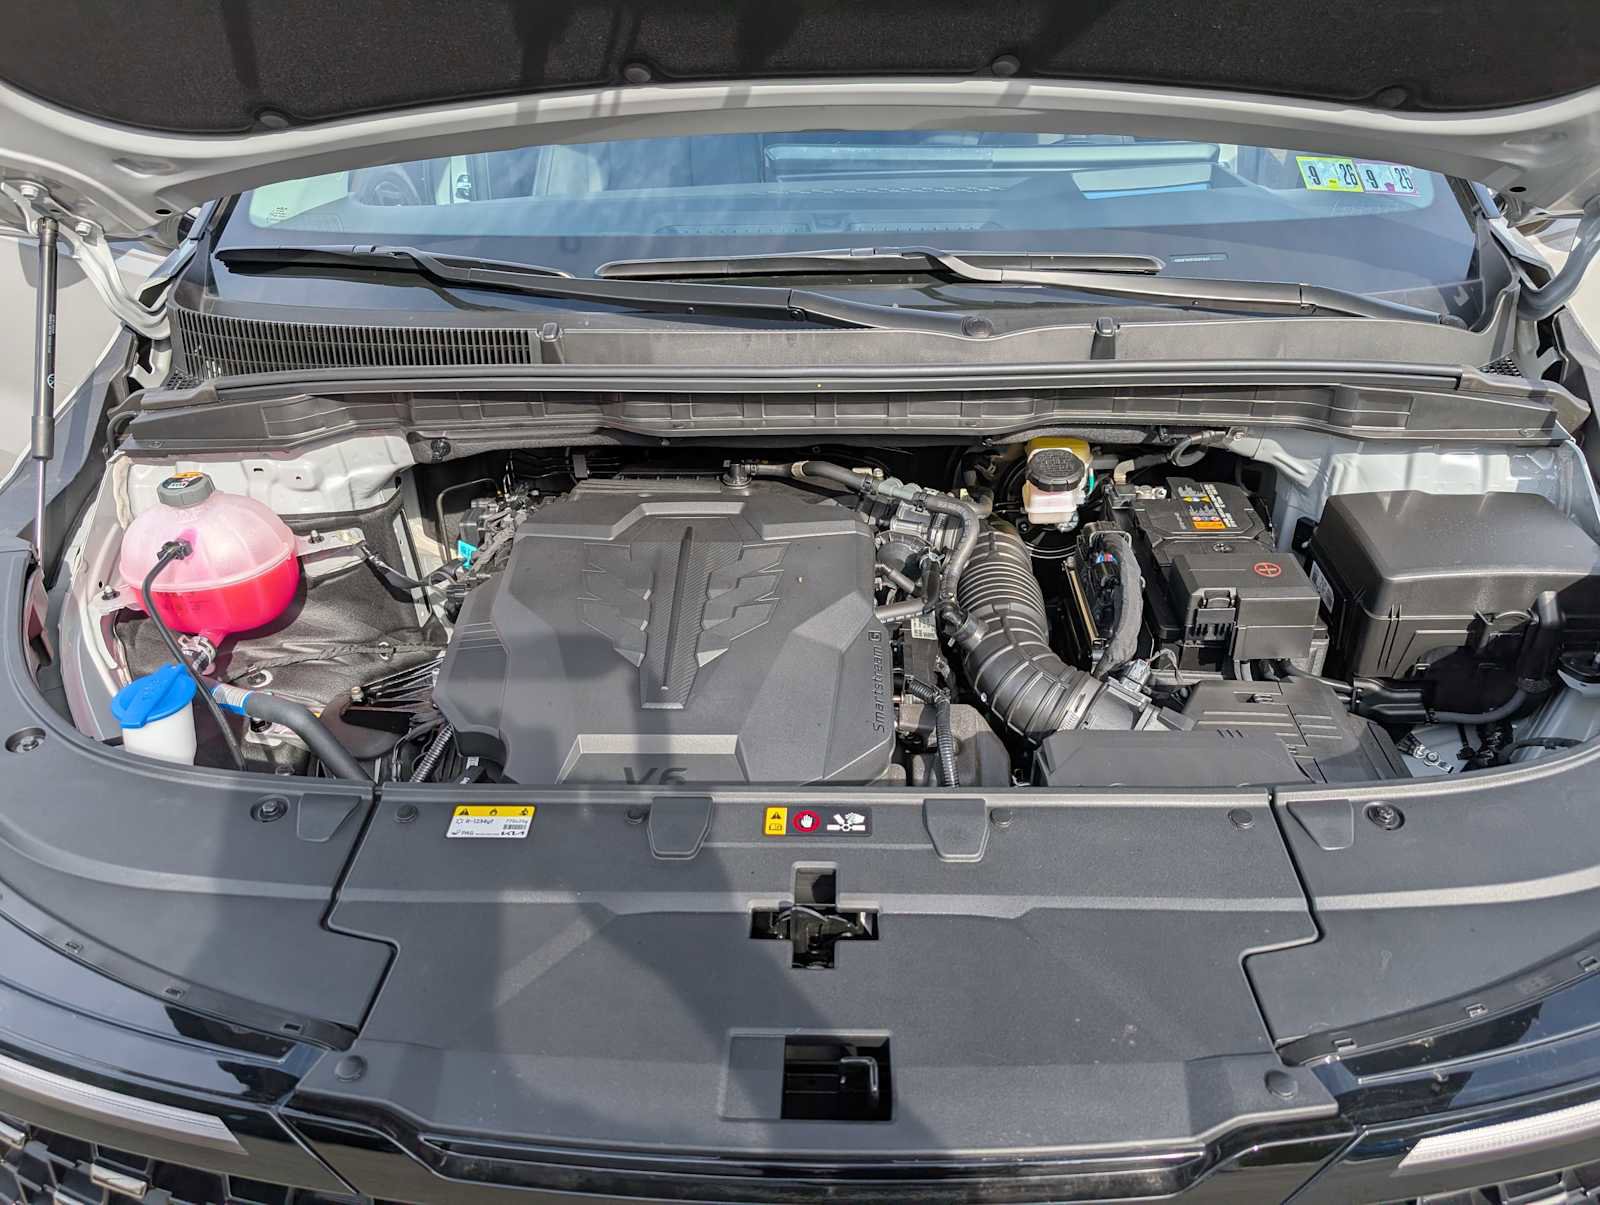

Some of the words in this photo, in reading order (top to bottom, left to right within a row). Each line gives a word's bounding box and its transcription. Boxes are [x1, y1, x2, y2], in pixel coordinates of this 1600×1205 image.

[1308, 165, 1321, 185] 9
[1339, 163, 1359, 186] 26
[1366, 169, 1379, 189] 9
[1394, 167, 1414, 190] 26
[872, 646, 886, 734] Smartstream
[623, 766, 688, 785] V6
